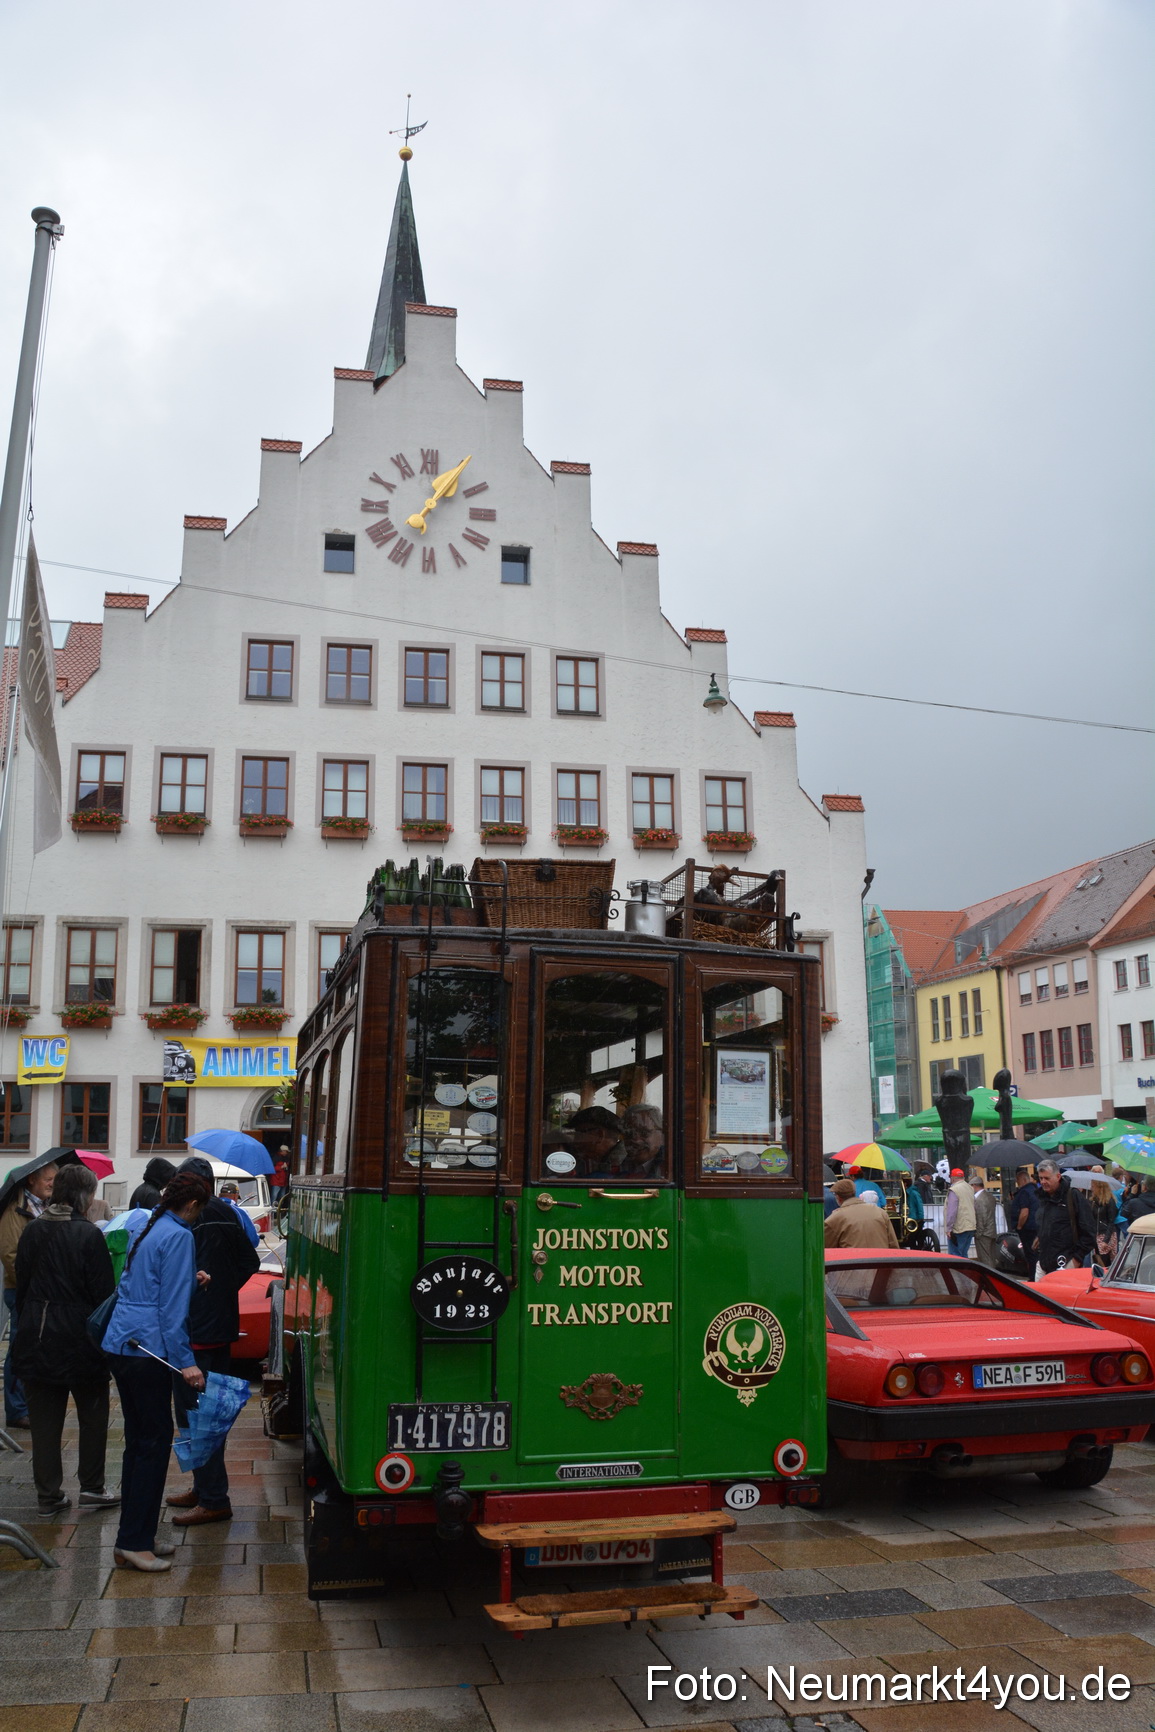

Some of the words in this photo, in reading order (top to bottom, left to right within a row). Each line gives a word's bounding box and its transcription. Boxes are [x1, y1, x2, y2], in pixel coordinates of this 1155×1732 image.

[390, 452, 415, 480] XI
[419, 448, 439, 475] XII
[369, 472, 397, 493] X
[463, 481, 489, 498] II
[361, 498, 389, 513] IX
[469, 507, 496, 521] III
[448, 543, 467, 568] V
[23, 1038, 66, 1067] WC
[201, 1046, 297, 1077] ANMEL
[532, 1226, 669, 1250] JOHNSTON'S
[416, 1262, 503, 1294] Baujahr
[558, 1265, 643, 1287] MOTOR
[434, 1304, 489, 1318] 1923
[527, 1302, 673, 1325] TRANSPORT
[708, 1305, 753, 1341] NUNQUAM
[754, 1308, 774, 1326] NON
[768, 1326, 783, 1367] PARATUS
[983, 1366, 1014, 1385] NEA
[1023, 1365, 1033, 1383] F
[1035, 1363, 1064, 1382] 59H
[562, 1465, 638, 1478] INTERNATIONAL
[731, 1487, 755, 1504] GB
